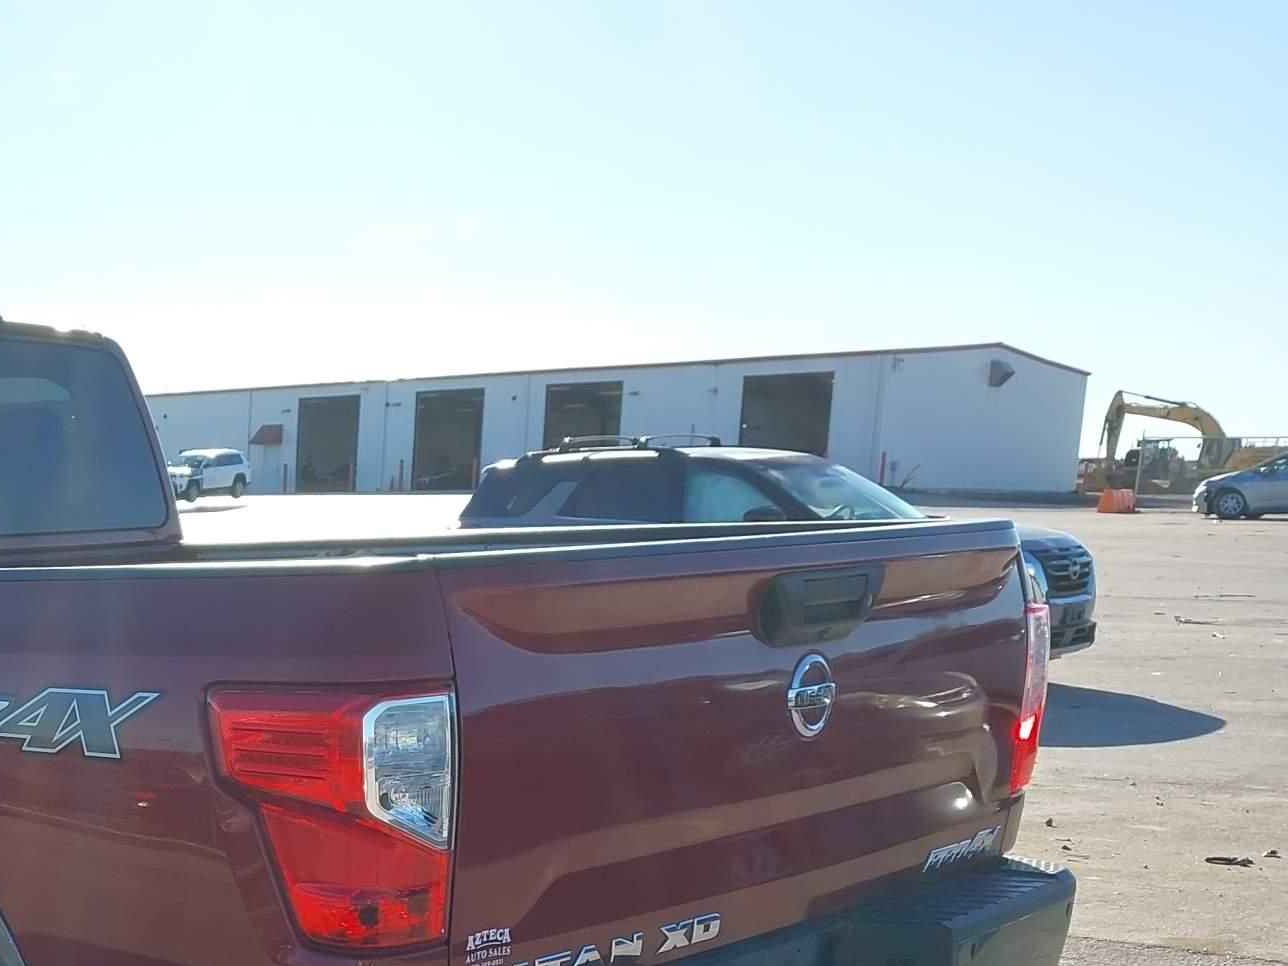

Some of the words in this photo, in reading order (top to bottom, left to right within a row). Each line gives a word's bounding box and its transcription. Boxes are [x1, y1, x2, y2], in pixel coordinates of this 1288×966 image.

[465, 928, 511, 951] AZTECA
[655, 911, 721, 955] XD
[465, 949, 488, 965] AUTO
[488, 945, 511, 958] SALES
